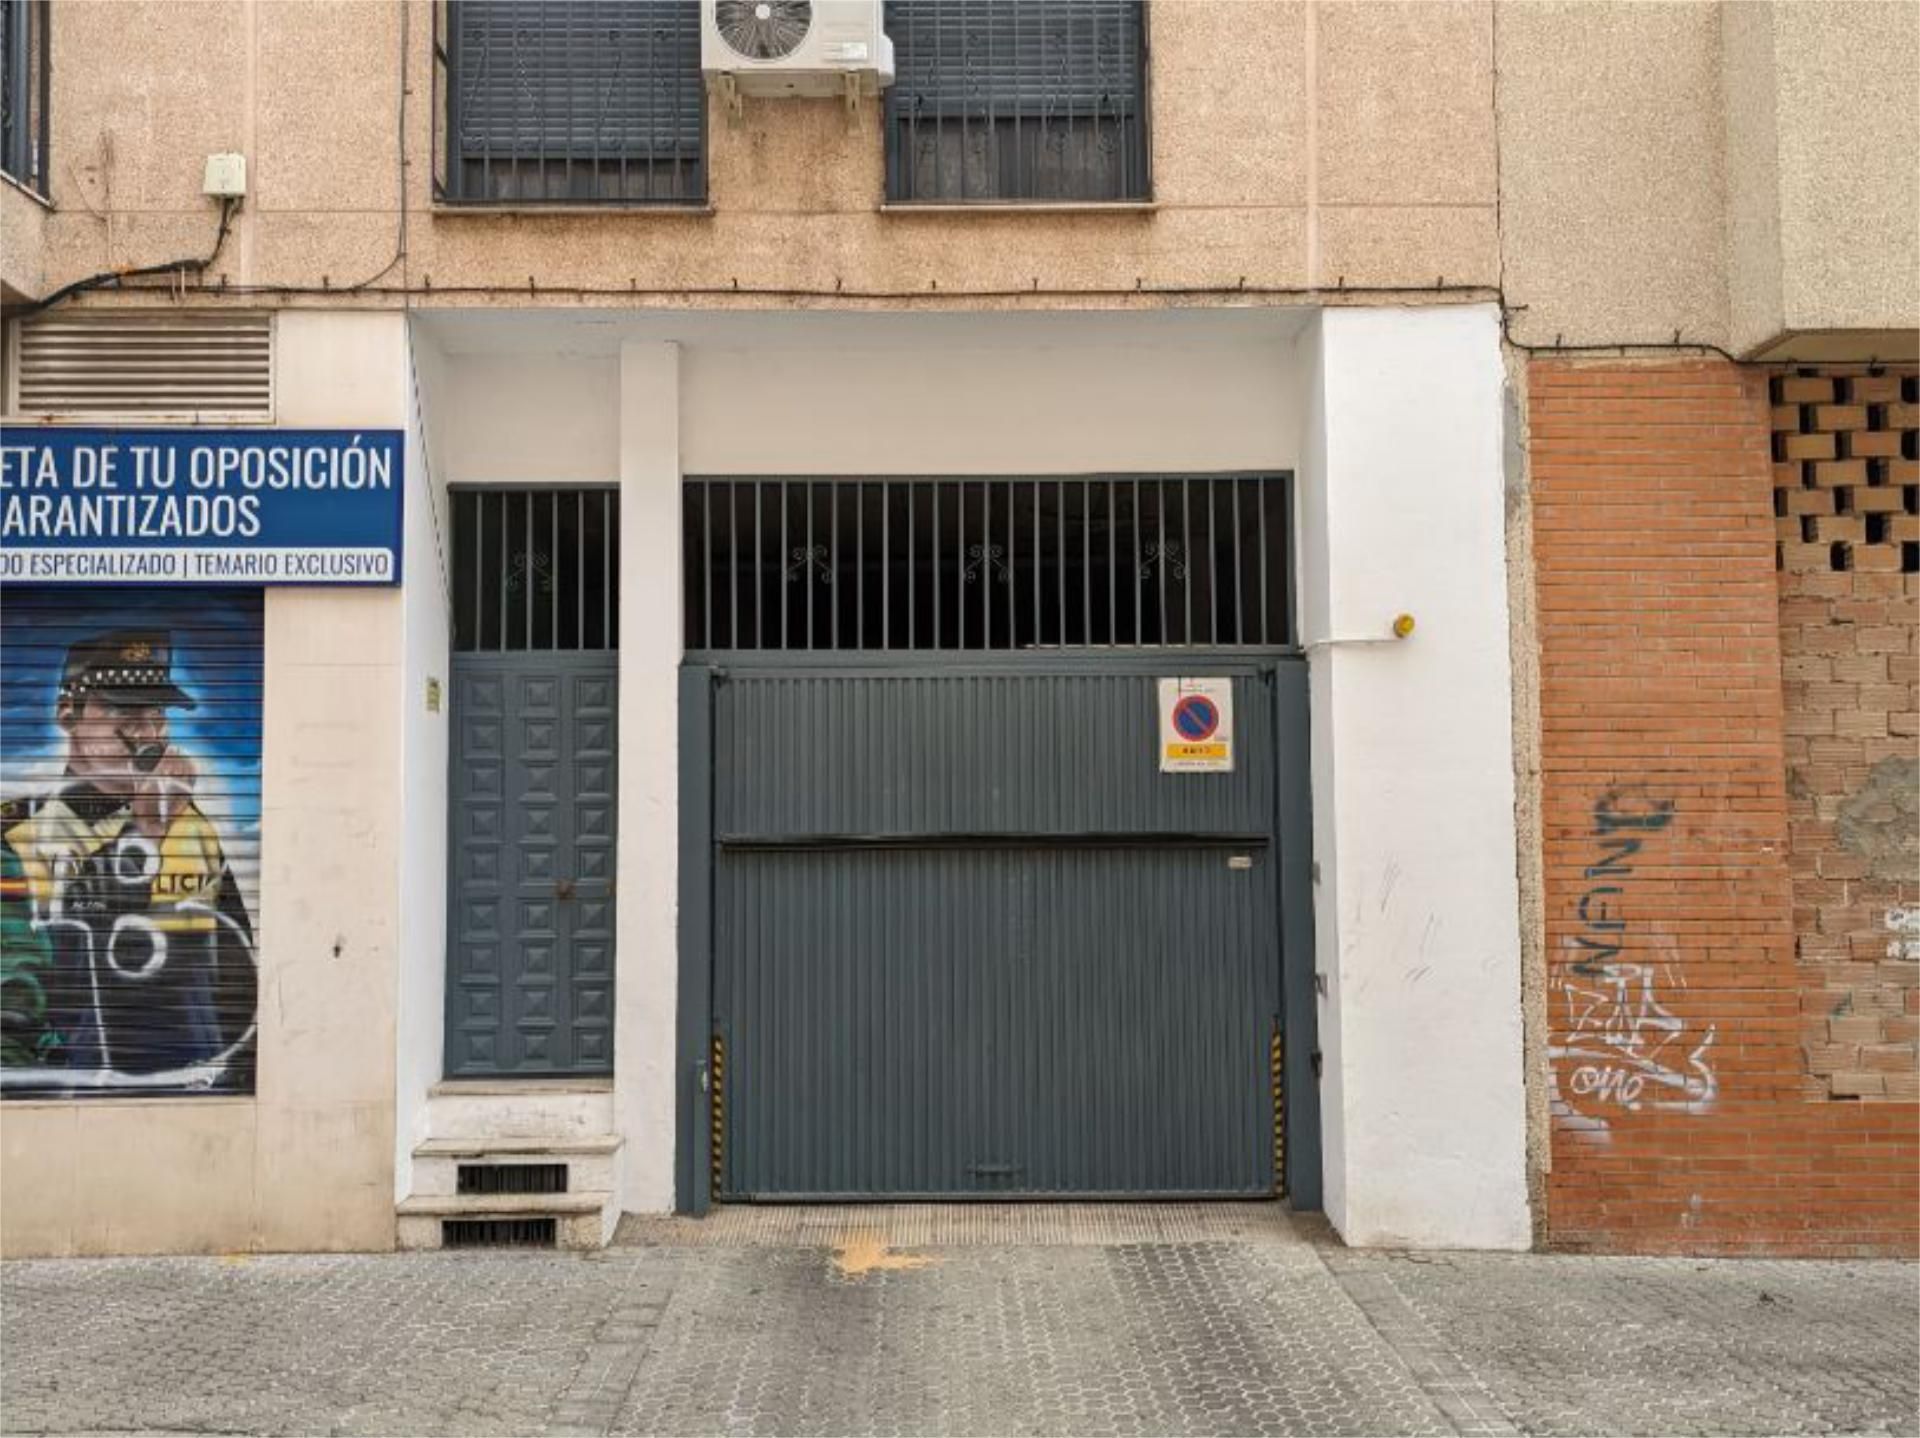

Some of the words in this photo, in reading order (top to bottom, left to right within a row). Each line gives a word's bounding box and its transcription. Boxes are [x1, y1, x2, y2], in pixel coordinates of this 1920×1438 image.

[0, 446, 59, 489] ETA
[72, 446, 118, 489] DE
[130, 446, 175, 489] TU
[190, 435, 391, 490] OPOSICIÓN
[2, 495, 261, 537] ARANTIZADOS
[30, 553, 173, 576] ESPECIALIZADO
[196, 553, 278, 576] TEMARIO
[285, 553, 389, 576] EXCLUSIVO
